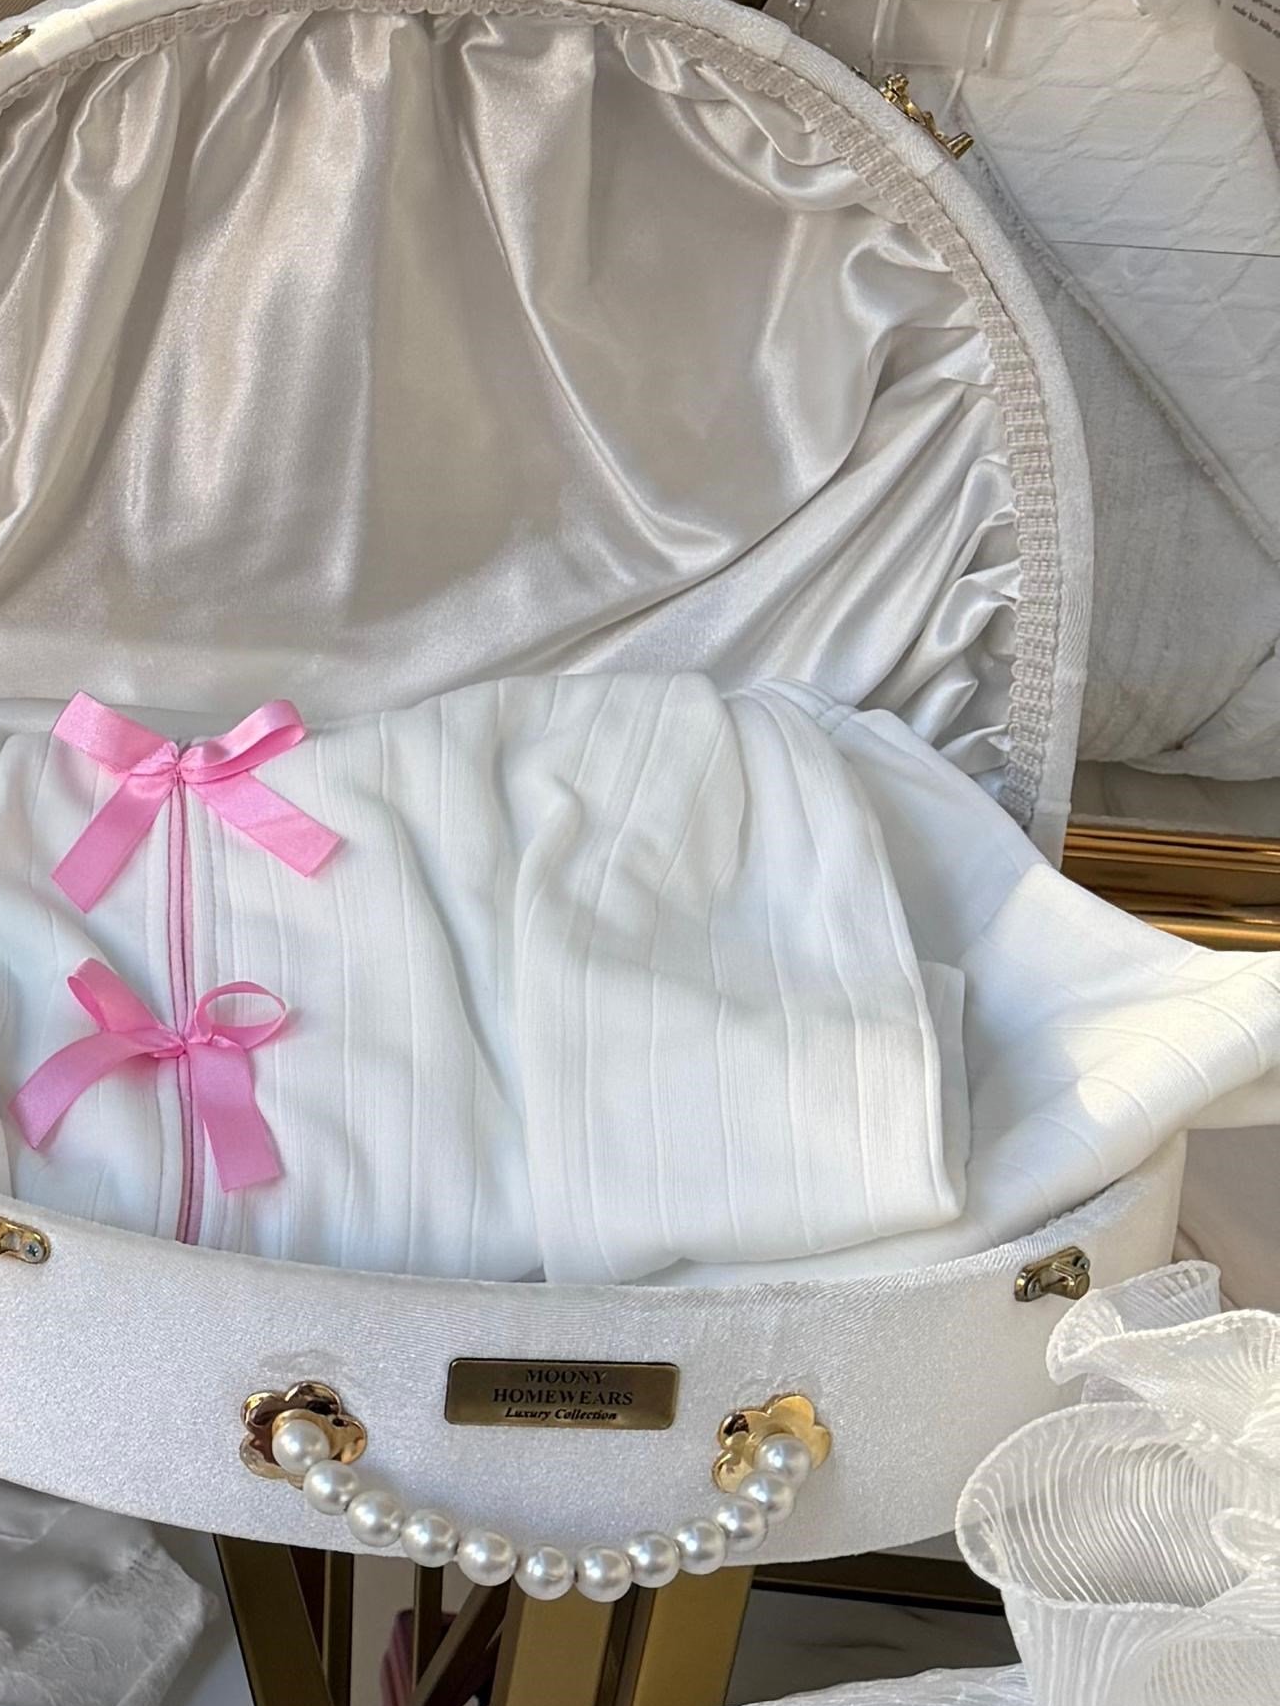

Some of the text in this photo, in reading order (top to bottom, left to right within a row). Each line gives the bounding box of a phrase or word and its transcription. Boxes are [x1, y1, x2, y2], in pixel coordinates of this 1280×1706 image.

[525, 1369, 607, 1385] MOONY
[493, 1388, 633, 1406] HOMEWEARS
[504, 1407, 618, 1421] Luxury Collection
